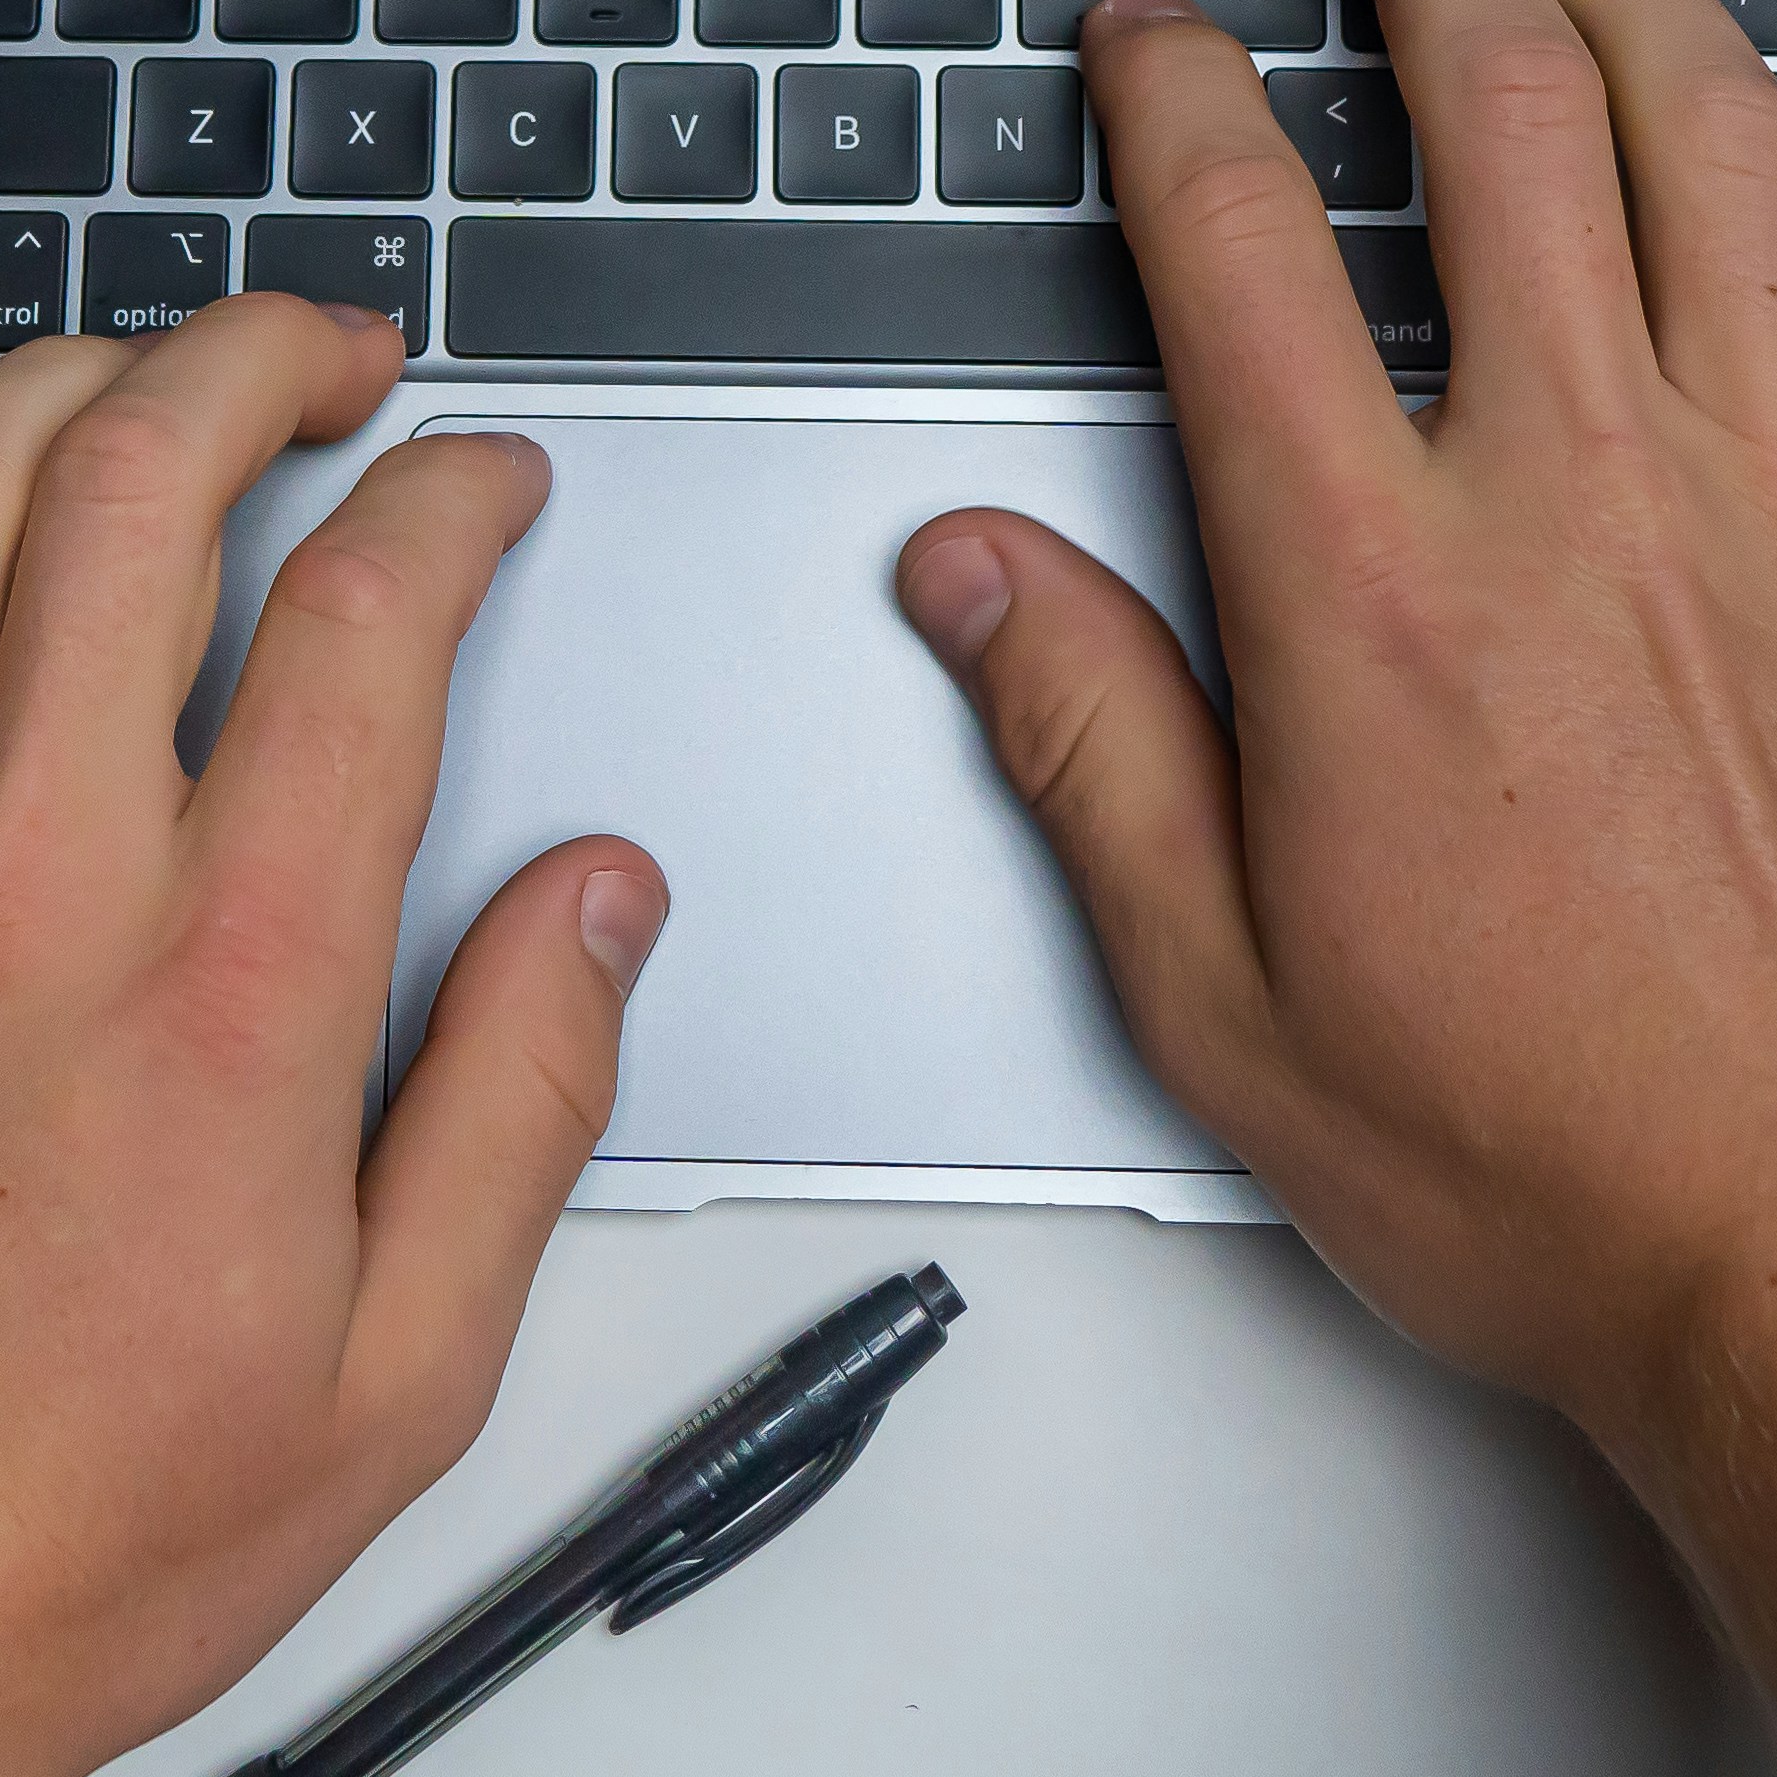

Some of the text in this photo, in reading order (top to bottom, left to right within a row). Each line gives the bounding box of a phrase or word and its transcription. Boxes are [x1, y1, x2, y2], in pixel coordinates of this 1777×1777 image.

[188, 109, 215, 144] Z
[348, 110, 376, 145] X
[509, 111, 537, 147] C
[670, 114, 700, 148] V
[834, 115, 860, 150] B
[996, 116, 1023, 152] N
